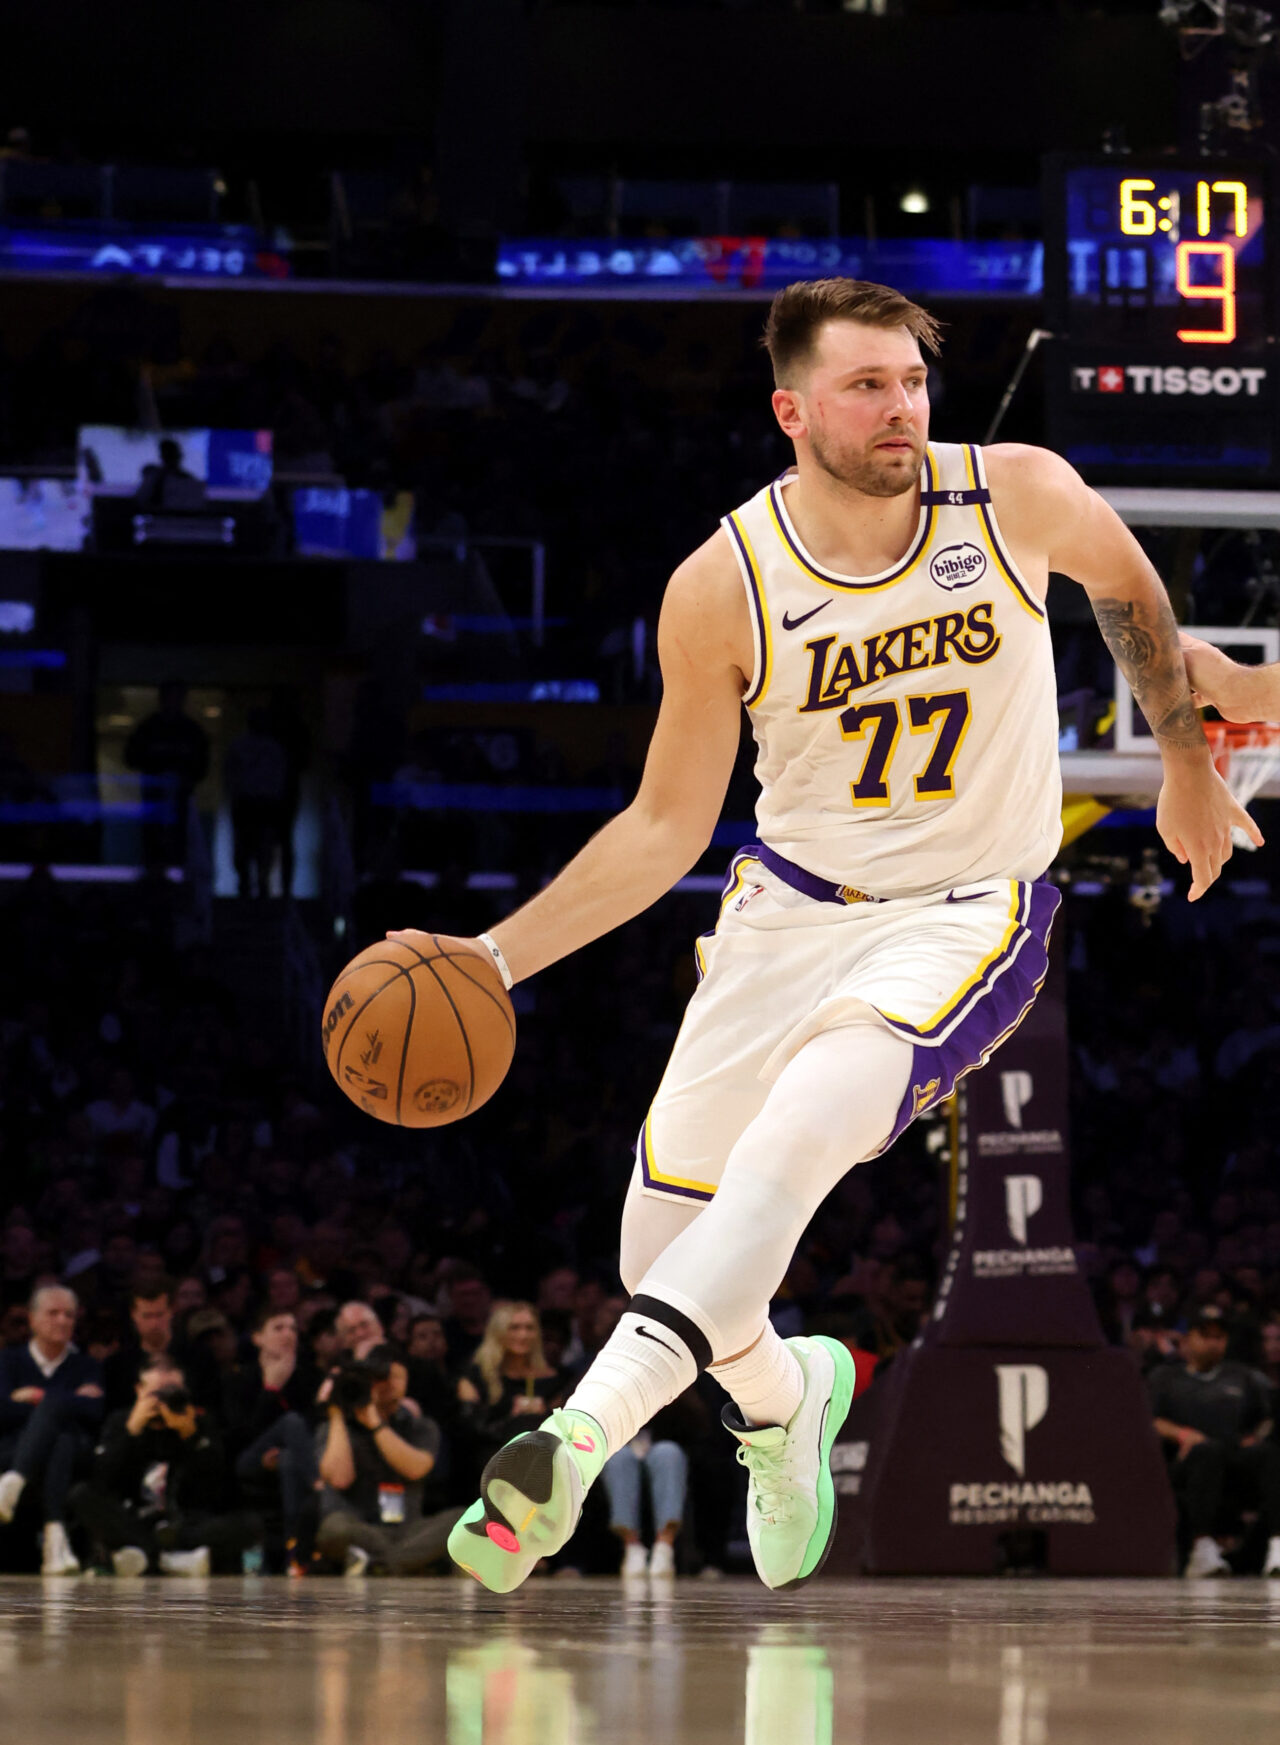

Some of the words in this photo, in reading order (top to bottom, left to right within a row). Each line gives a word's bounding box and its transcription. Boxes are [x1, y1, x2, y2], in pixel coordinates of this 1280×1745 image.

[1120, 178, 1248, 237] 6:17
[1175, 240, 1236, 344] 9
[1126, 366, 1266, 396] TISSOT
[948, 492, 964, 505] 44
[934, 555, 982, 577] bibigo
[797, 601, 1002, 713] LAKERS
[838, 688, 973, 808] 77
[950, 1481, 1093, 1507] PECHANGA
